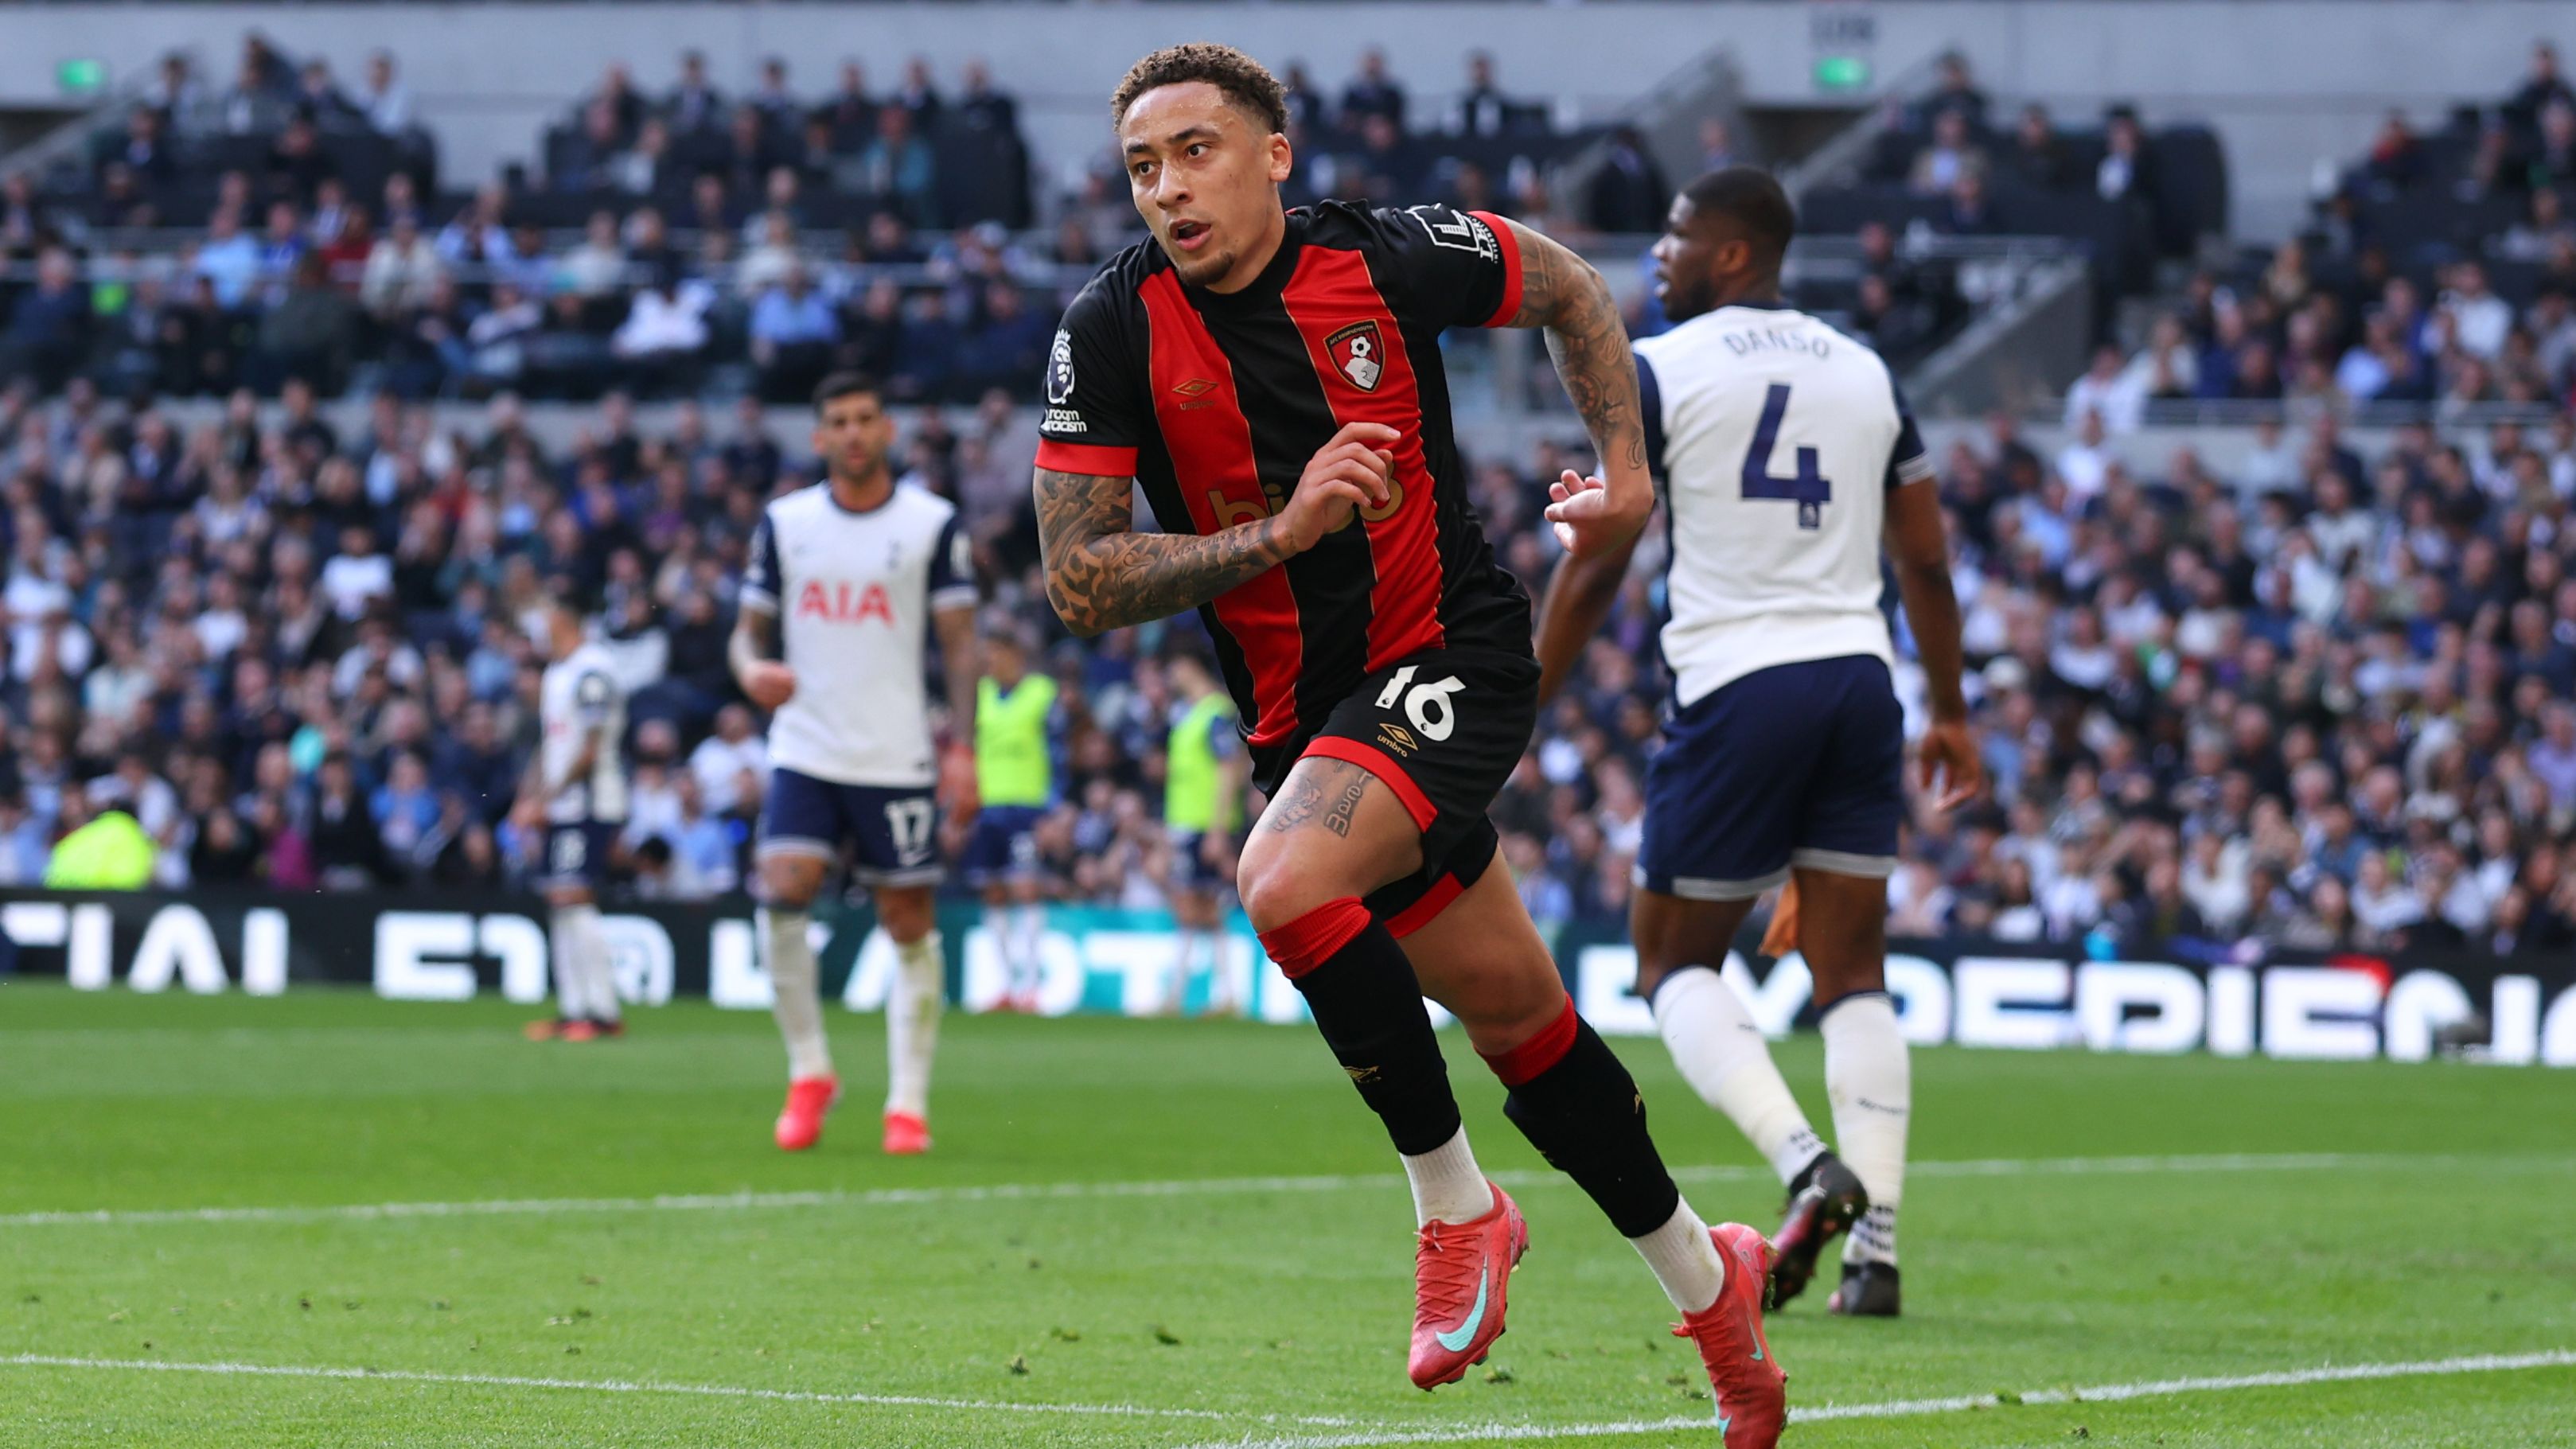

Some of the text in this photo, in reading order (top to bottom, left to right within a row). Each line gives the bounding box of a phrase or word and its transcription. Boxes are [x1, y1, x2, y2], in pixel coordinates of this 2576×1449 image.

[1723, 329, 1830, 359] DANSO
[1740, 383, 1833, 530] 4
[797, 579, 897, 629] AIA
[1374, 665, 1467, 742] 16
[1377, 734, 1408, 758] umbro
[884, 797, 936, 867] 17
